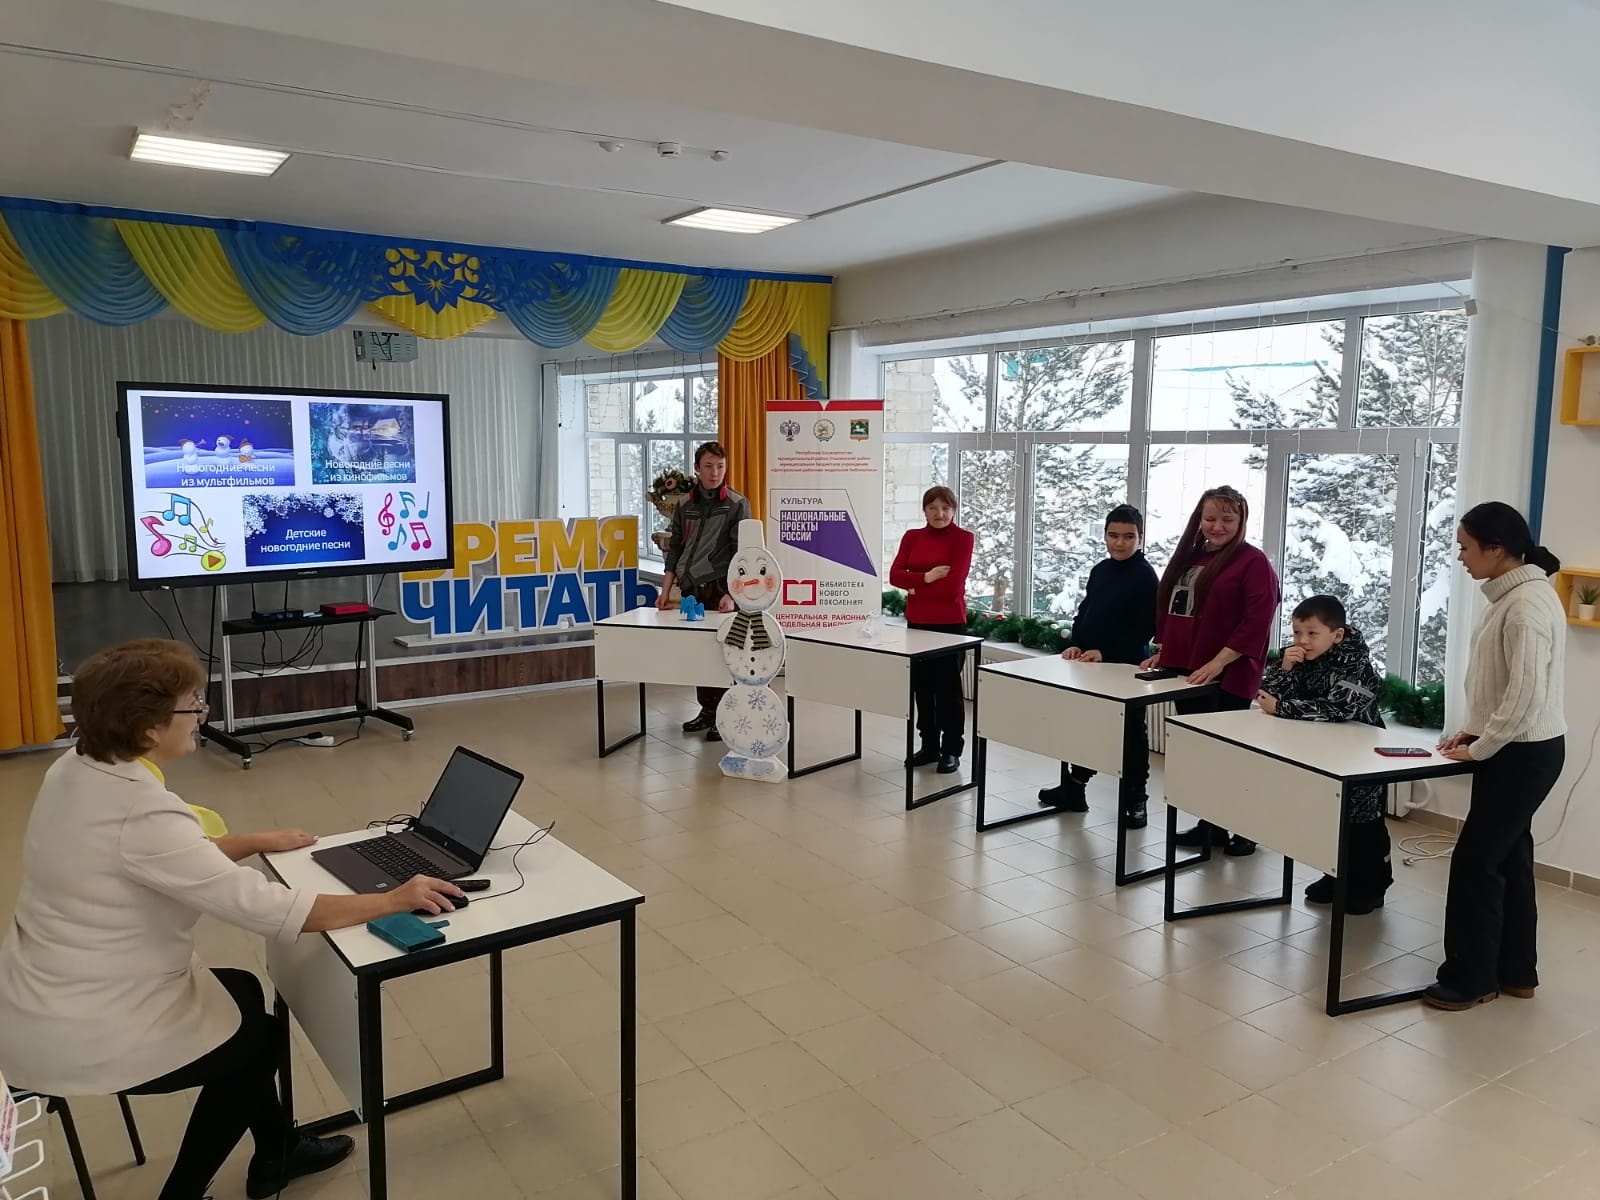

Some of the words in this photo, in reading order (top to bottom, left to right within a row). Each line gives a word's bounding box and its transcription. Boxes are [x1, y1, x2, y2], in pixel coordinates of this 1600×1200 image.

[245, 464, 276, 473] песни
[325, 459, 383, 470] Новогодние
[384, 461, 411, 469] песни
[181, 478, 195, 486] из
[197, 475, 275, 487] мультфильмов
[330, 474, 342, 482] из
[343, 472, 408, 482] кинофильмов
[780, 497, 823, 505] КУЛЬТУРА
[780, 511, 847, 522] НАЦИОНАЛЬНЫЕ
[780, 521, 819, 532] ПРОЕКТЫ
[285, 528, 327, 541] Детские
[780, 531, 812, 541] РОССИИ
[260, 542, 321, 553] новогодние
[322, 541, 351, 549] песни
[400, 517, 639, 581] РЕМЯ
[819, 589, 850, 597] НОВОГО
[401, 569, 659, 637] ЧИТАТЬ
[775, 613, 828, 621] ЦЕНТРАЛЬНАЯ
